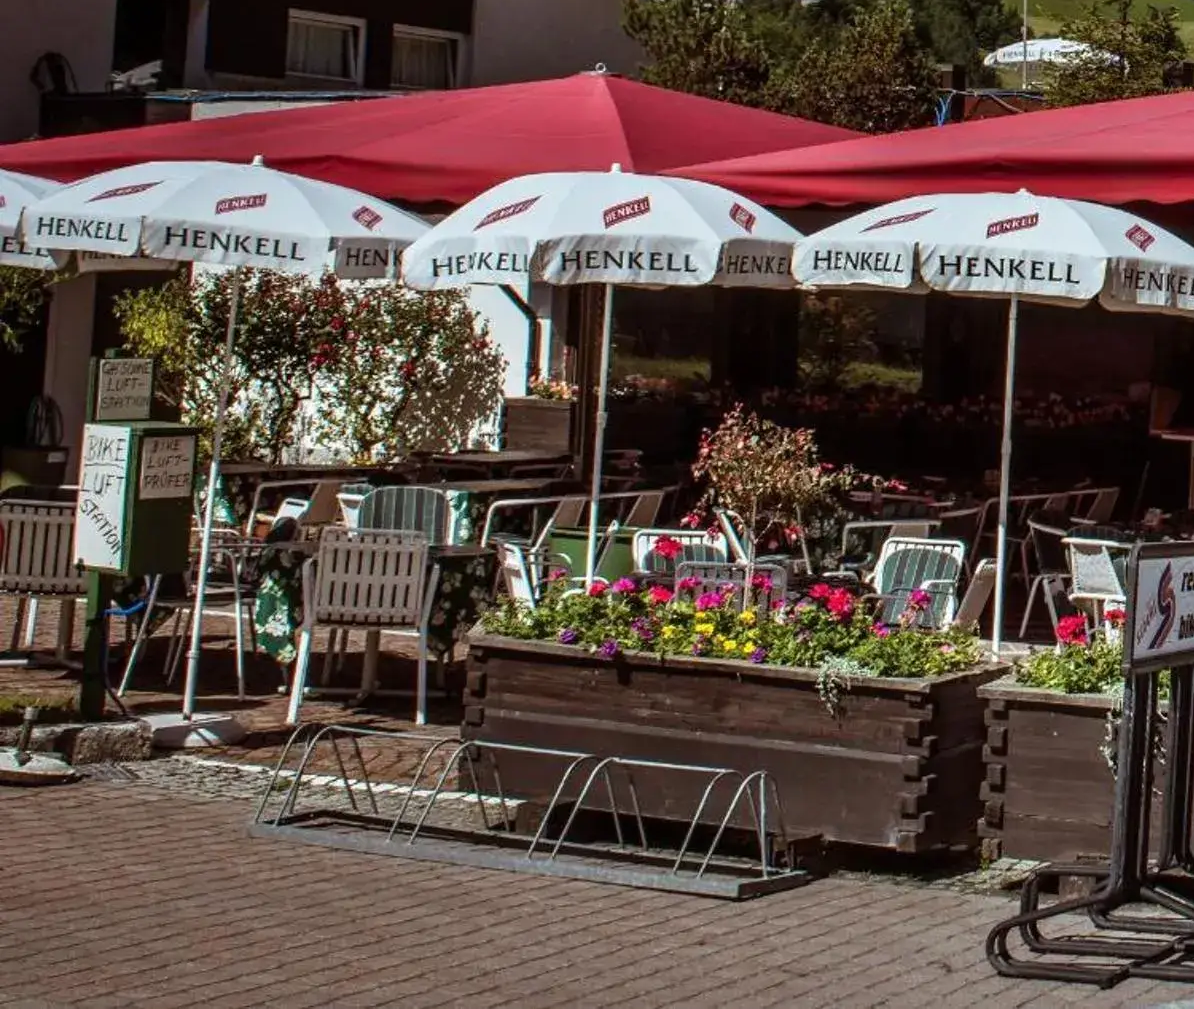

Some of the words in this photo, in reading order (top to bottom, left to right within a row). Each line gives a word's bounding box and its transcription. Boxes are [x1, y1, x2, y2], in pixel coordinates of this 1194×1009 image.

[36, 217, 128, 242] HENKELL
[164, 226, 305, 261] HENKELL
[345, 247, 404, 266] HENK
[561, 250, 699, 273] HENKELL
[813, 250, 904, 273] HENKELL
[938, 254, 1080, 284] HENKELL
[87, 436, 127, 462] BIKE
[81, 473, 125, 495] LUFT
